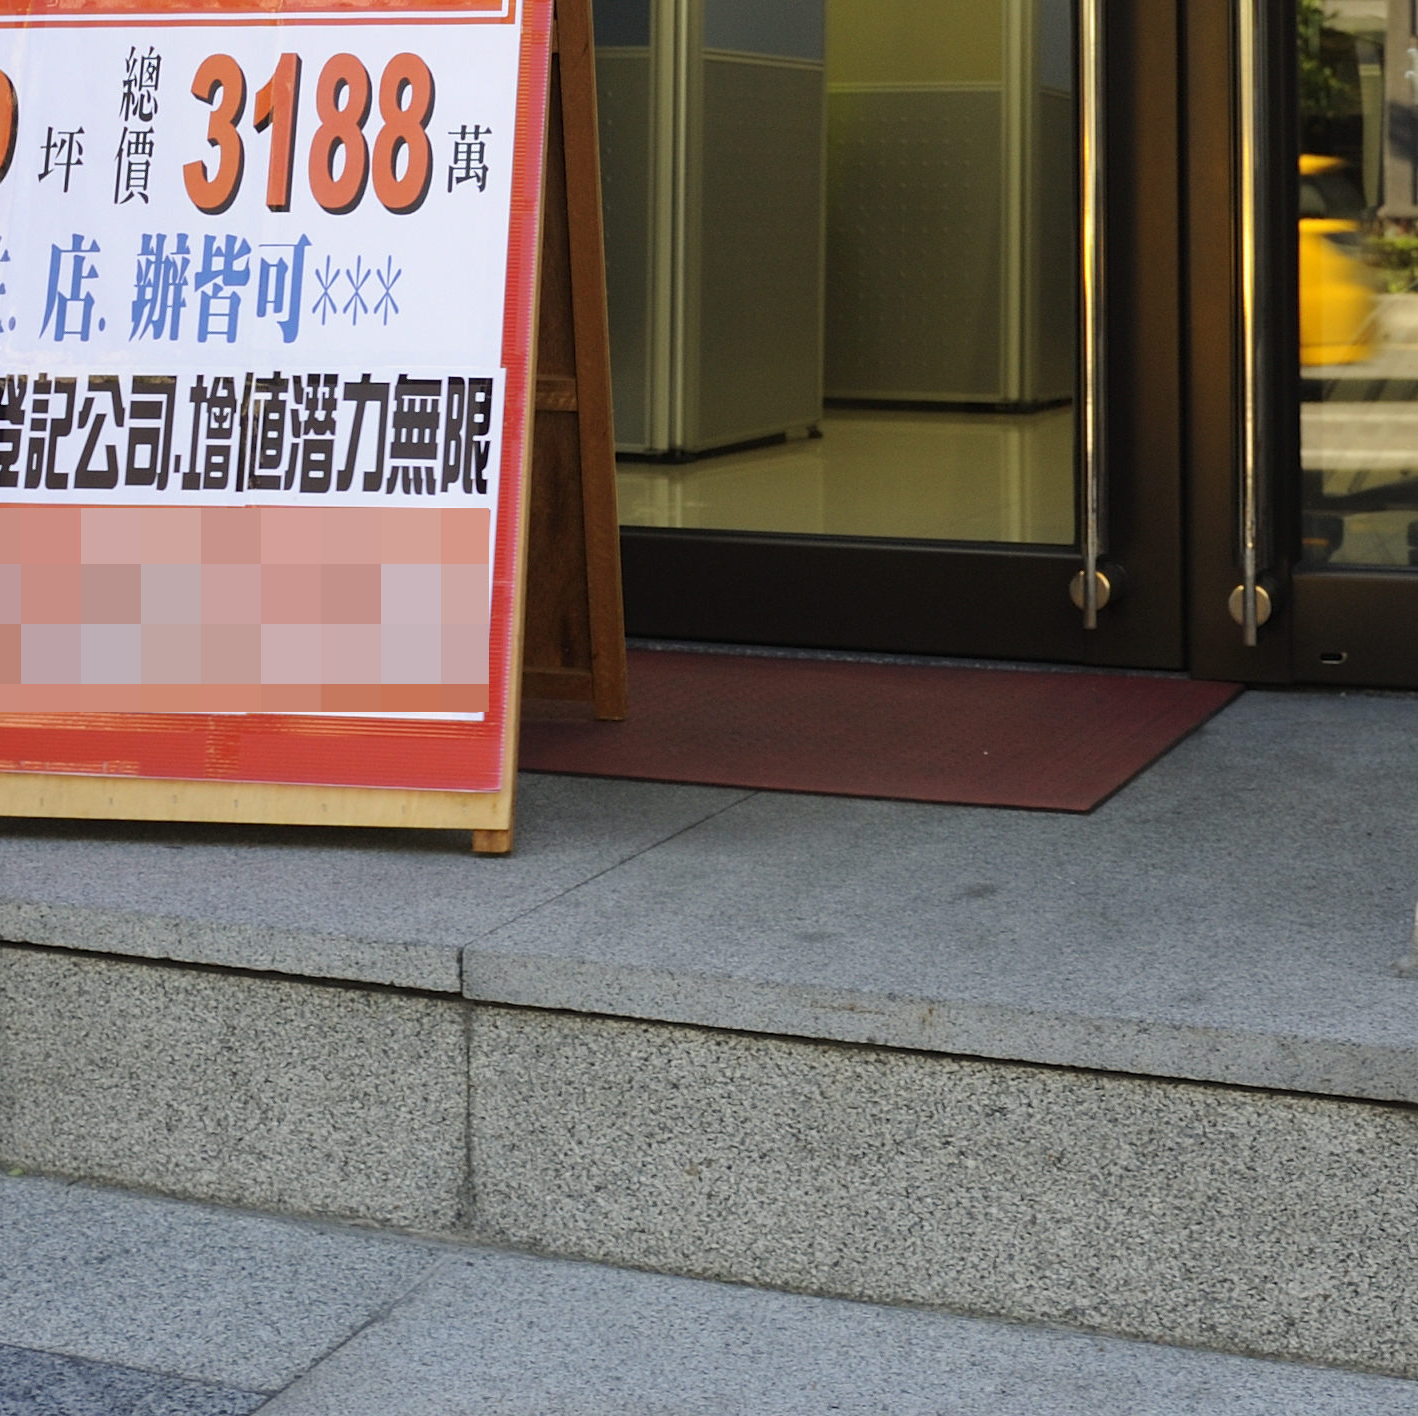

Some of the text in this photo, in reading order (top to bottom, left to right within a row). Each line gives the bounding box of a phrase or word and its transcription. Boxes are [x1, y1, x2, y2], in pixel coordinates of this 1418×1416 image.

[38, 125, 85, 194] 坪
[112, 45, 163, 206] 總價
[182, 51, 437, 216] 3188
[446, 124, 493, 194] 萬
